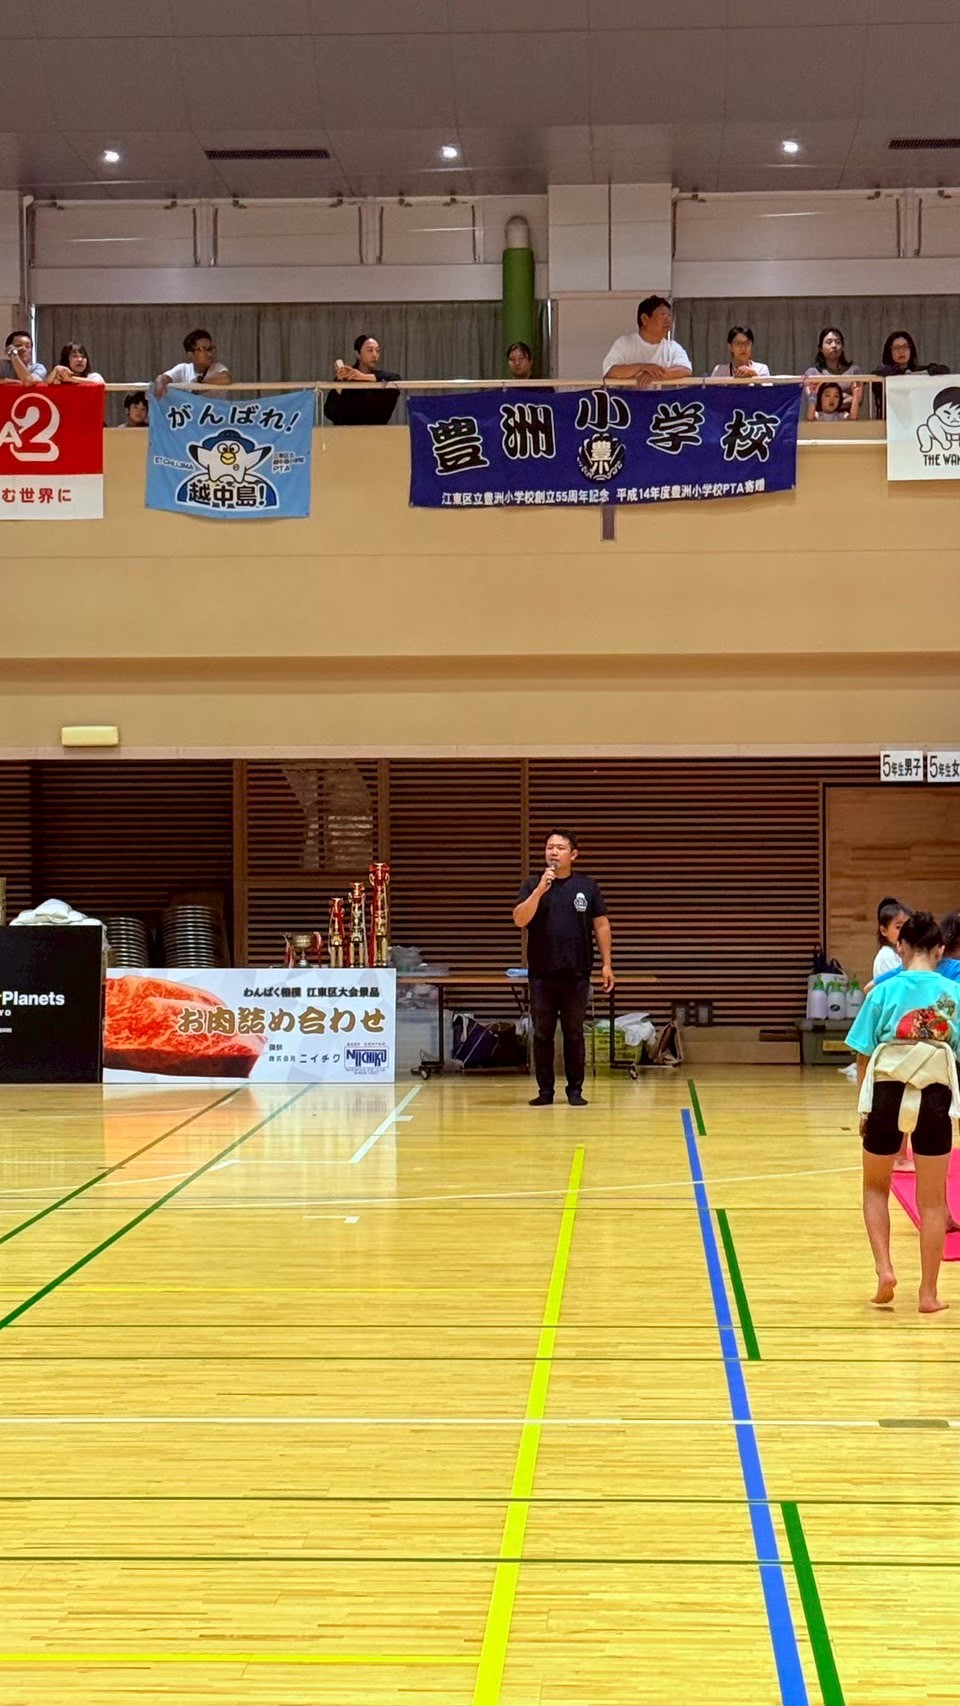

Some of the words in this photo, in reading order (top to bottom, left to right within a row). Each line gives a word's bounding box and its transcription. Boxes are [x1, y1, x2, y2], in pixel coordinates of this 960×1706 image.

[167, 404, 301, 434] がんばれ!
[427, 389, 780, 476] 豊洲小学校
[923, 454, 941, 466] THE
[1, 487, 72, 504] む世界に
[188, 481, 267, 508] 越中島!
[441, 488, 610, 506] 江東区立豊洲小学校創立55周年記念
[882, 754, 922, 778] 5年生男子
[306, 986, 380, 998] 江東区大会景品
[178, 1006, 386, 1035] お肉詰め合わせ
